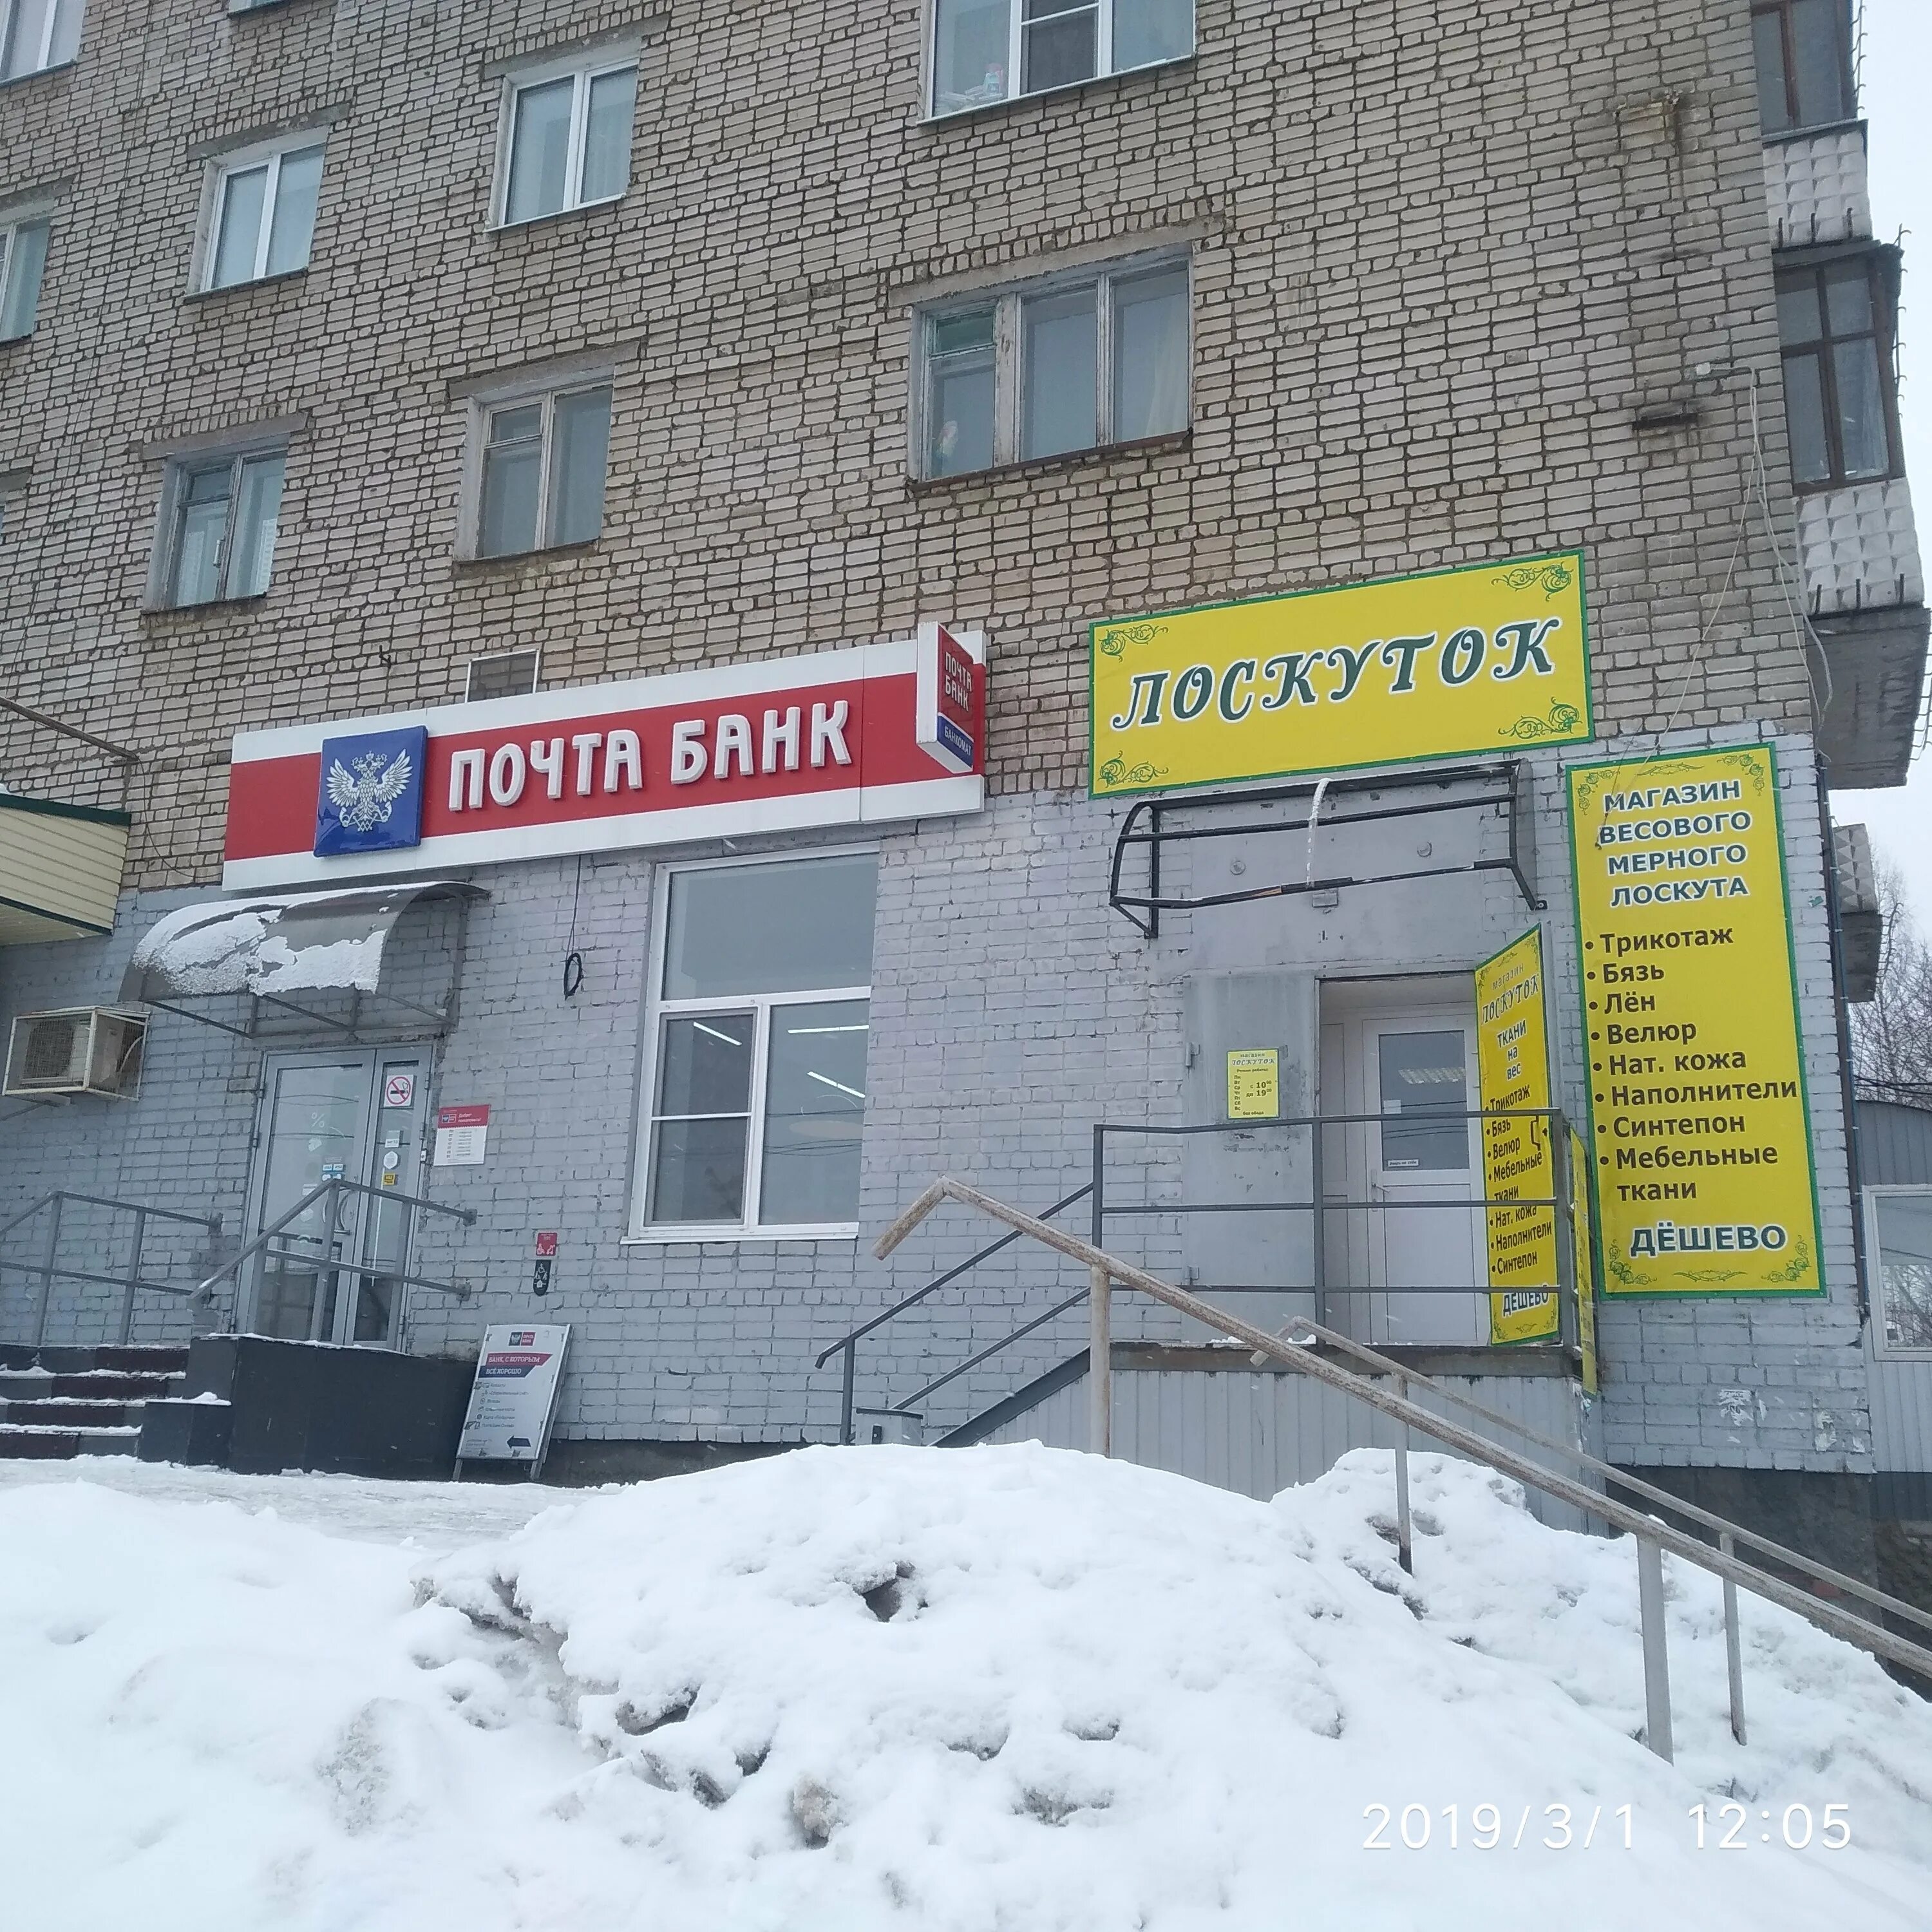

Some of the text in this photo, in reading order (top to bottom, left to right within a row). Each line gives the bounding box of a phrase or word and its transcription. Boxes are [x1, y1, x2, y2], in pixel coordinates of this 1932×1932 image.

[945, 652, 972, 692] ПОЧТА
[1112, 618, 1560, 730] ЛОСКУТОК
[945, 674, 969, 712] БАНК
[944, 726, 971, 756] БАНКОМАТ
[448, 699, 852, 812] ПОЧТА БАНК
[1604, 780, 1741, 812] МАГАЗИН
[1600, 811, 1752, 844] ВЕСОВОГО
[1608, 844, 1747, 875] МЕРНОГО
[1611, 876, 1749, 907] ЛОСКУТА
[1600, 927, 1734, 958] Трикотаж
[1493, 963, 1524, 990] магазин
[1603, 963, 1664, 984] Бязь
[1481, 974, 1539, 1025] ЛОСКУТОК
[1604, 991, 1655, 1014] Лён
[1497, 1020, 1526, 1048] ТКАНИ
[1607, 1023, 1696, 1045] Велюр
[1508, 1046, 1518, 1062] на
[1609, 1051, 1746, 1075] Нат. кожа
[1507, 1064, 1521, 1081] вес
[1490, 1084, 1530, 1111] Трикотаж
[1612, 1081, 1797, 1106] Наполнители
[1492, 1119, 1511, 1137] Бязь
[1613, 1115, 1745, 1138] Синтепон
[1493, 1137, 1520, 1160] Велюр
[1616, 1146, 1777, 1170] Мебельные
[1494, 1151, 1542, 1182] Мебельные
[1494, 1185, 1519, 1200] ткани
[1617, 1181, 1697, 1201] ткани
[1495, 1206, 1537, 1229] Нат. кожа
[1496, 1221, 1552, 1251] Наполнители
[1630, 1221, 1788, 1258] ДЁШЕВО
[1497, 1251, 1538, 1274] Синтепон
